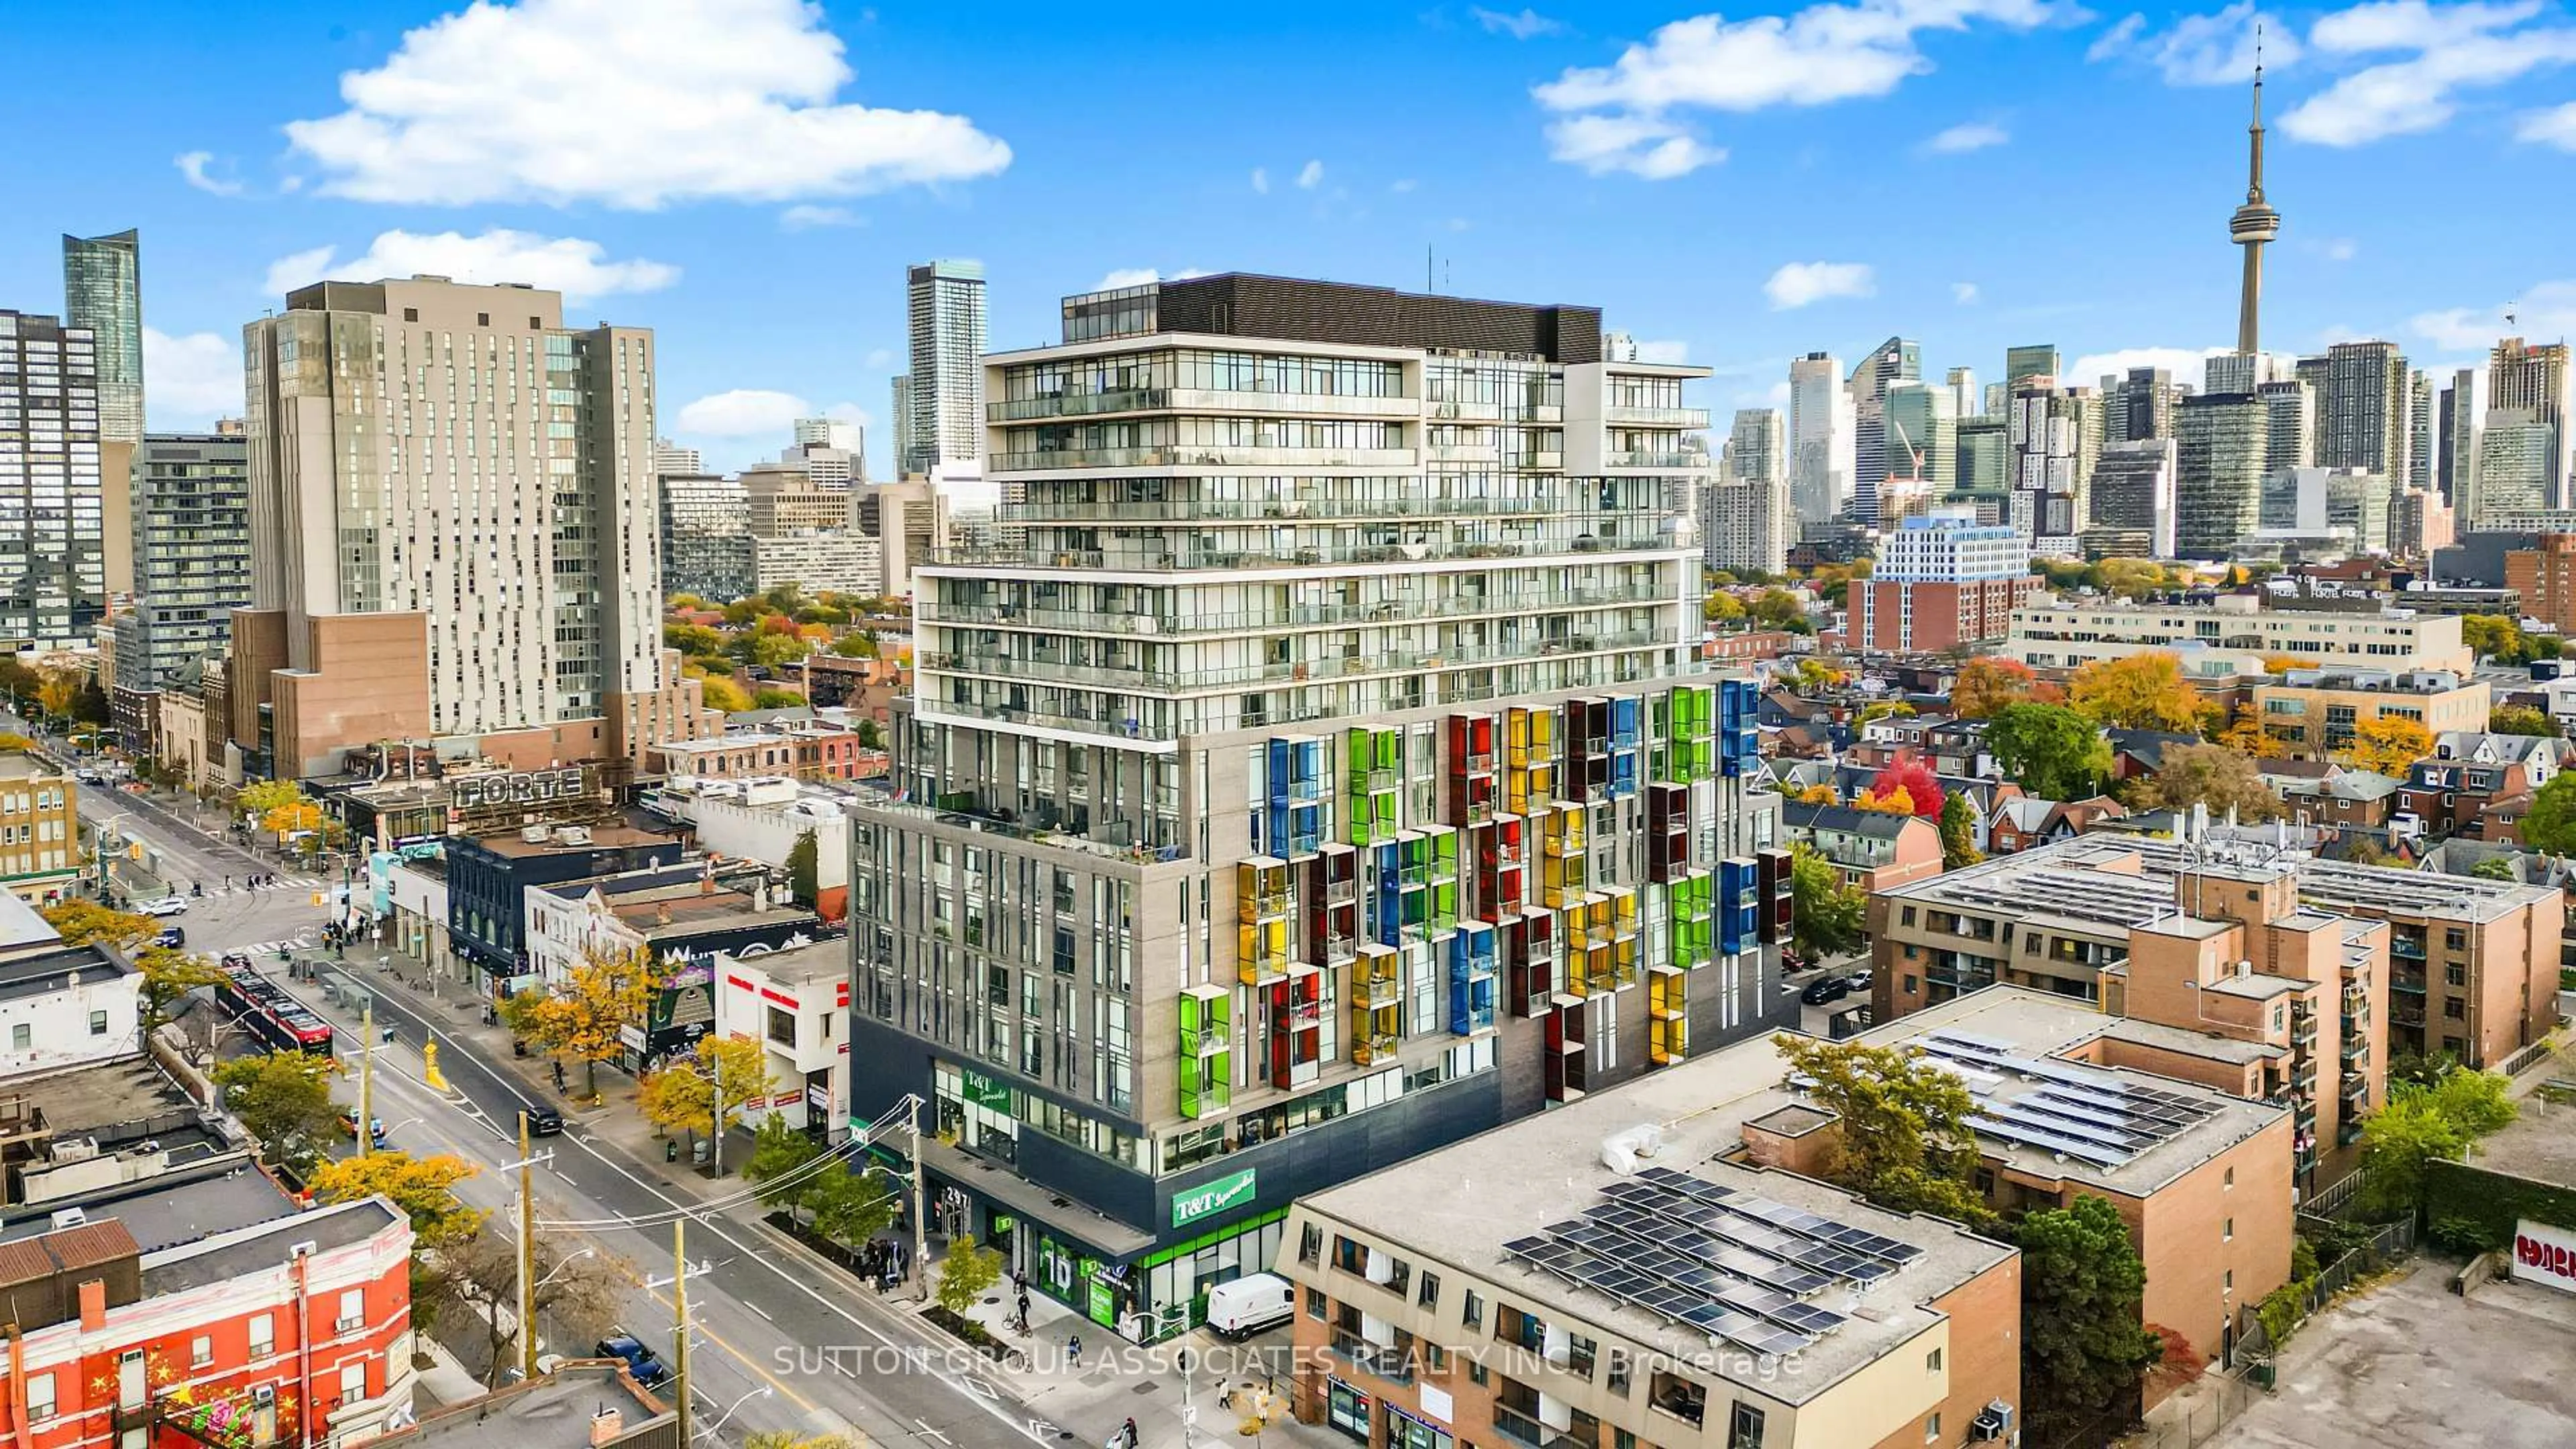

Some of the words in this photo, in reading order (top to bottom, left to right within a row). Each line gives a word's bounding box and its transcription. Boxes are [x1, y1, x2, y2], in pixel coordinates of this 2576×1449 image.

[456, 767, 582, 807] FORTE
[947, 1186, 967, 1208] 297
[1177, 1193, 1215, 1221] T&T
